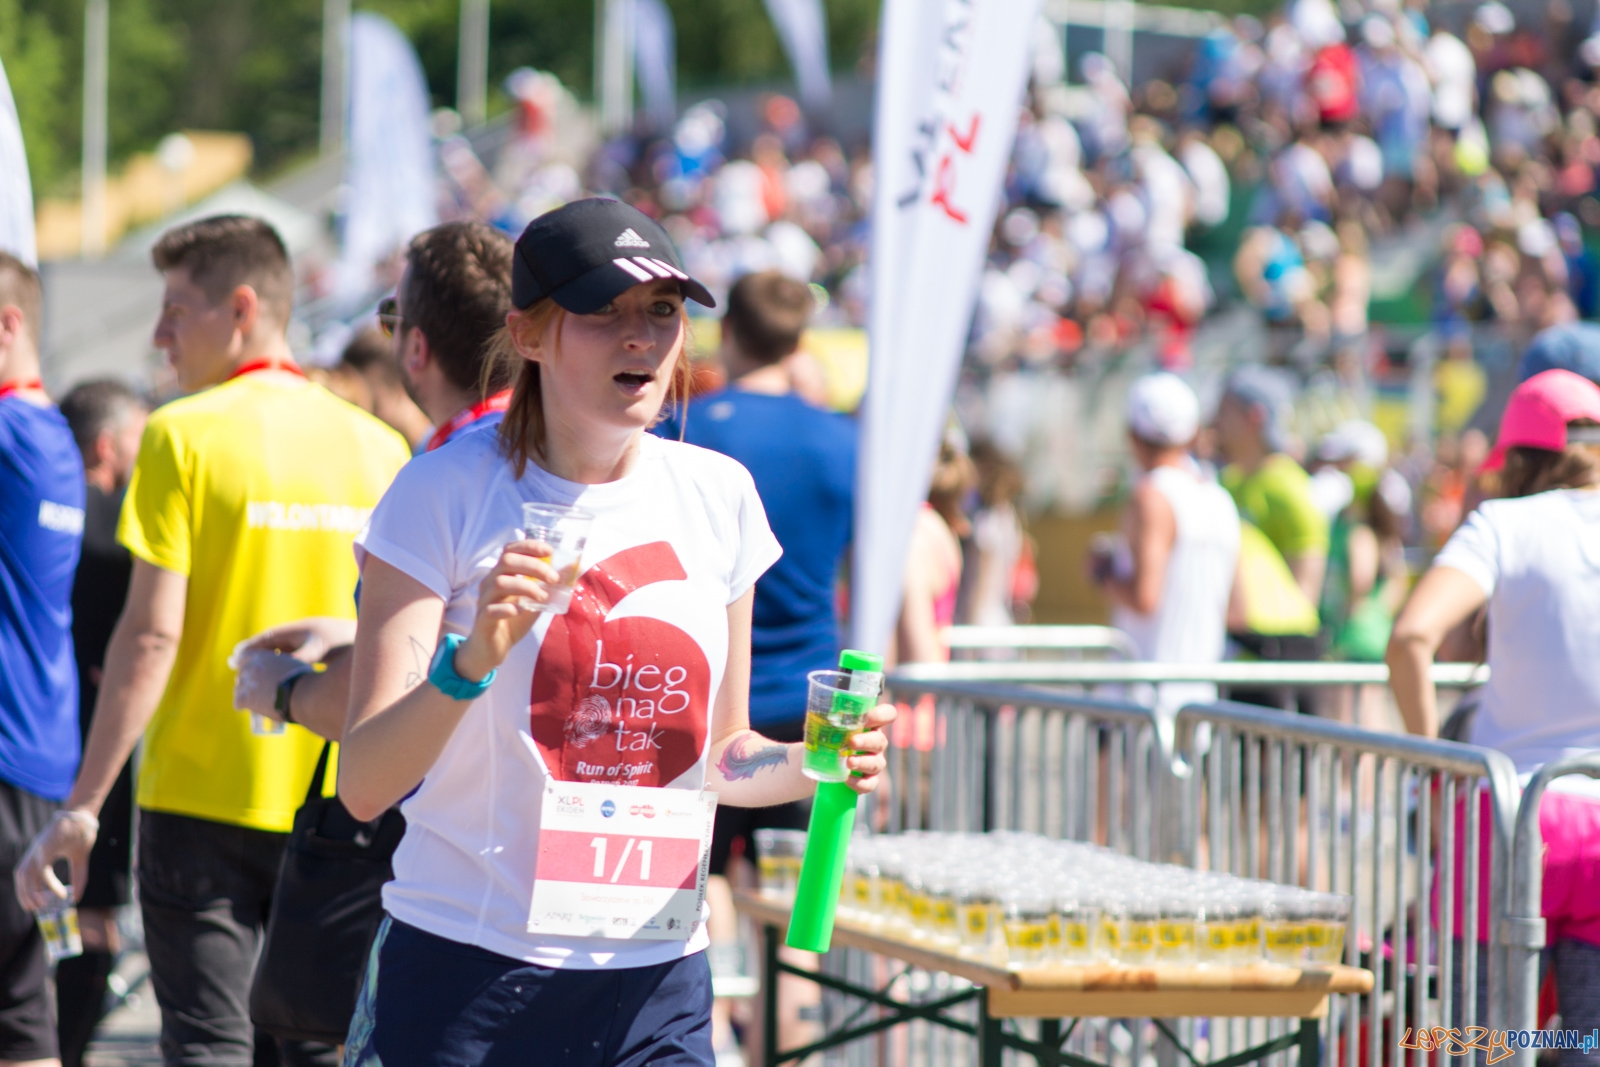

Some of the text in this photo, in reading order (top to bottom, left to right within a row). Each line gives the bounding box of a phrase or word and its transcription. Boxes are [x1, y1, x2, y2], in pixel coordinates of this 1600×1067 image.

[614, 239, 650, 248] adidas
[589, 639, 690, 714] bieg
[616, 697, 655, 718] na
[614, 720, 665, 752] tak
[576, 761, 653, 779] Run of Spirit
[556, 806, 584, 814] EKIDEN
[590, 837, 653, 883] 1/1
